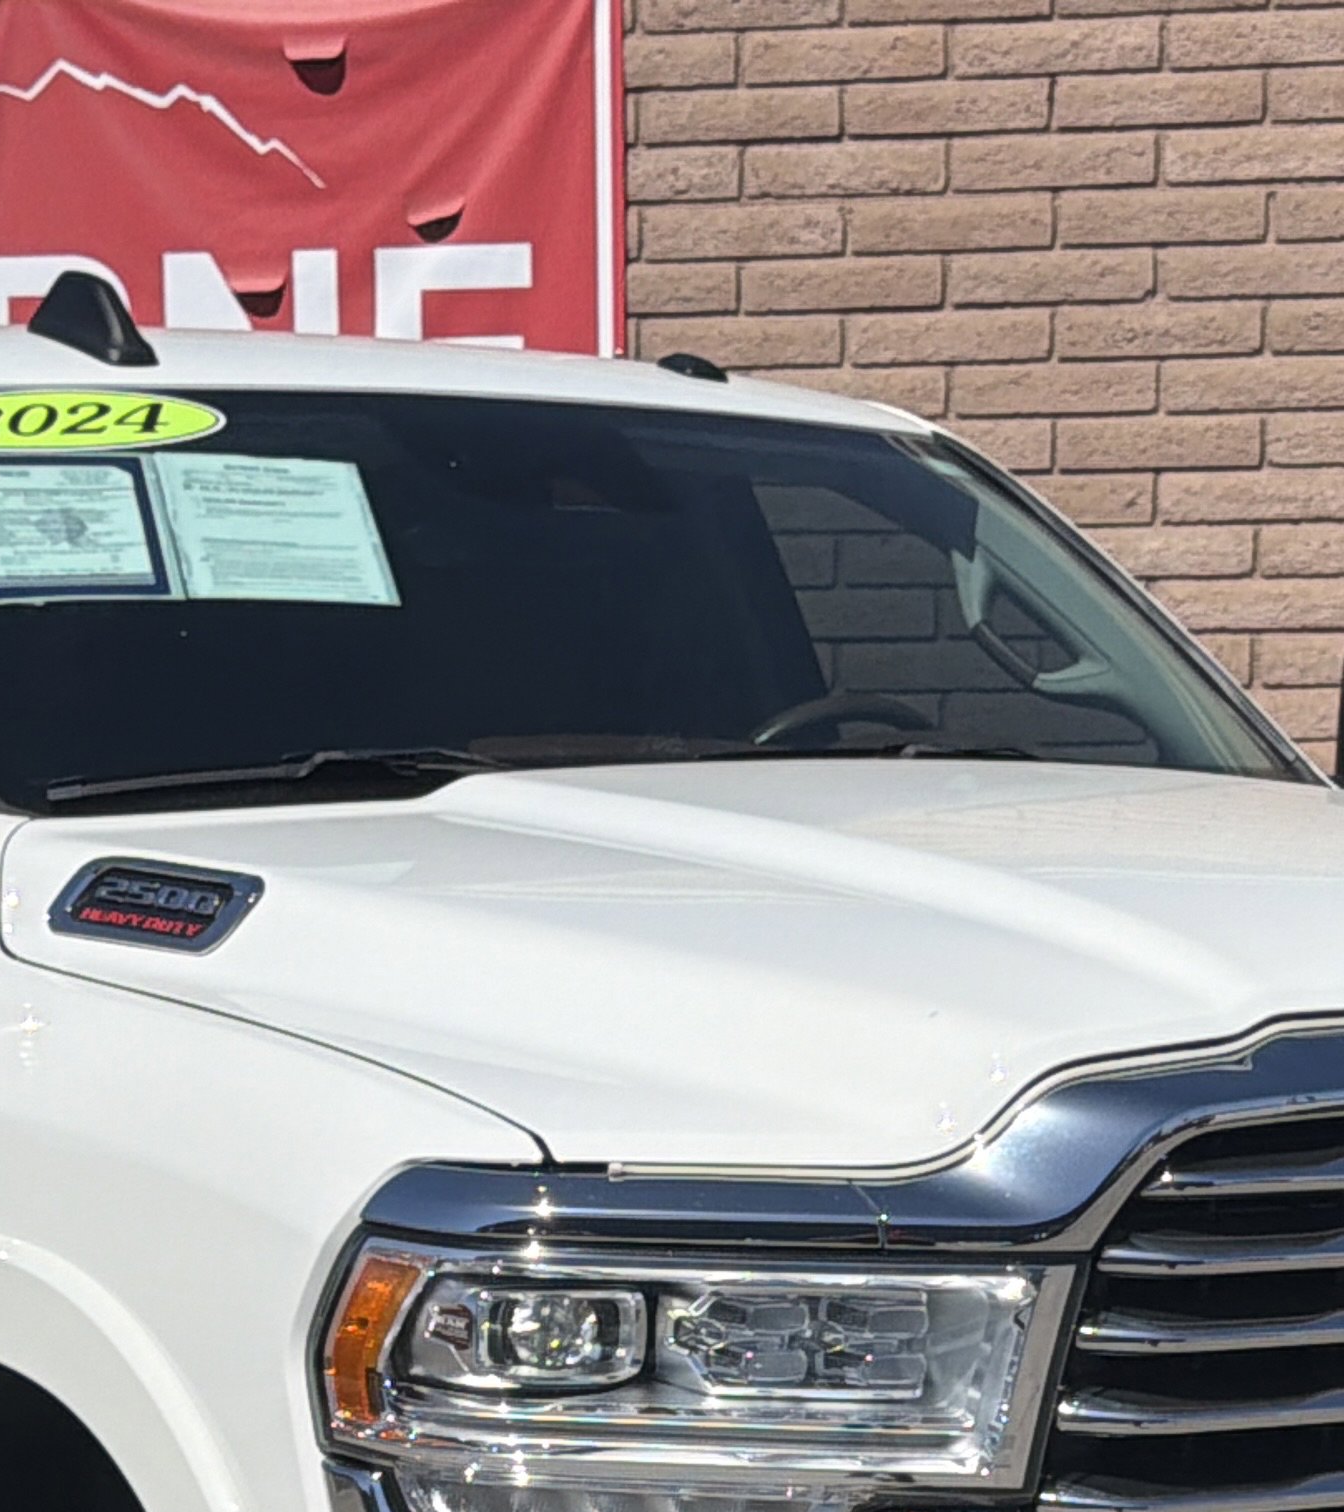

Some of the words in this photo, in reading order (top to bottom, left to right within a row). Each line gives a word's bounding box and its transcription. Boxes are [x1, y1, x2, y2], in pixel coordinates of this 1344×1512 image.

[95, 876, 222, 915] 2500
[80, 906, 143, 926] HEAVY
[142, 915, 204, 937] DUTY
